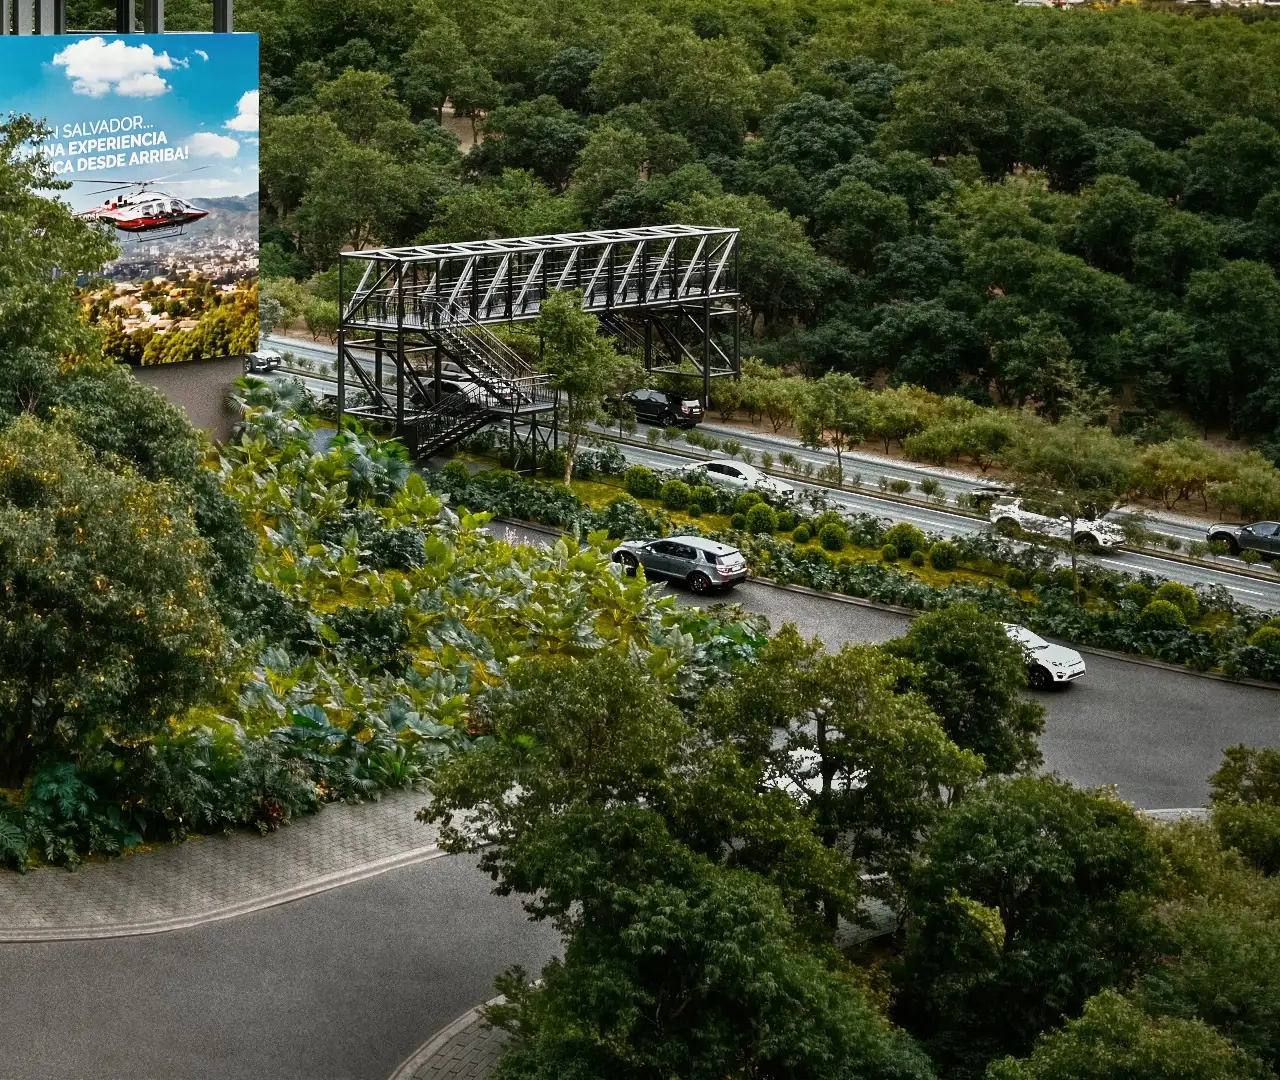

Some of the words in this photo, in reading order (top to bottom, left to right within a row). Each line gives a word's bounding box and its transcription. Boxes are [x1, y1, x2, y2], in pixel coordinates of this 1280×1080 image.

[62, 115, 154, 137] SALVADOR...
[68, 130, 168, 156] EXPERIENCIA
[77, 154, 126, 172] DESDE
[128, 145, 189, 166] ARRIBA!
